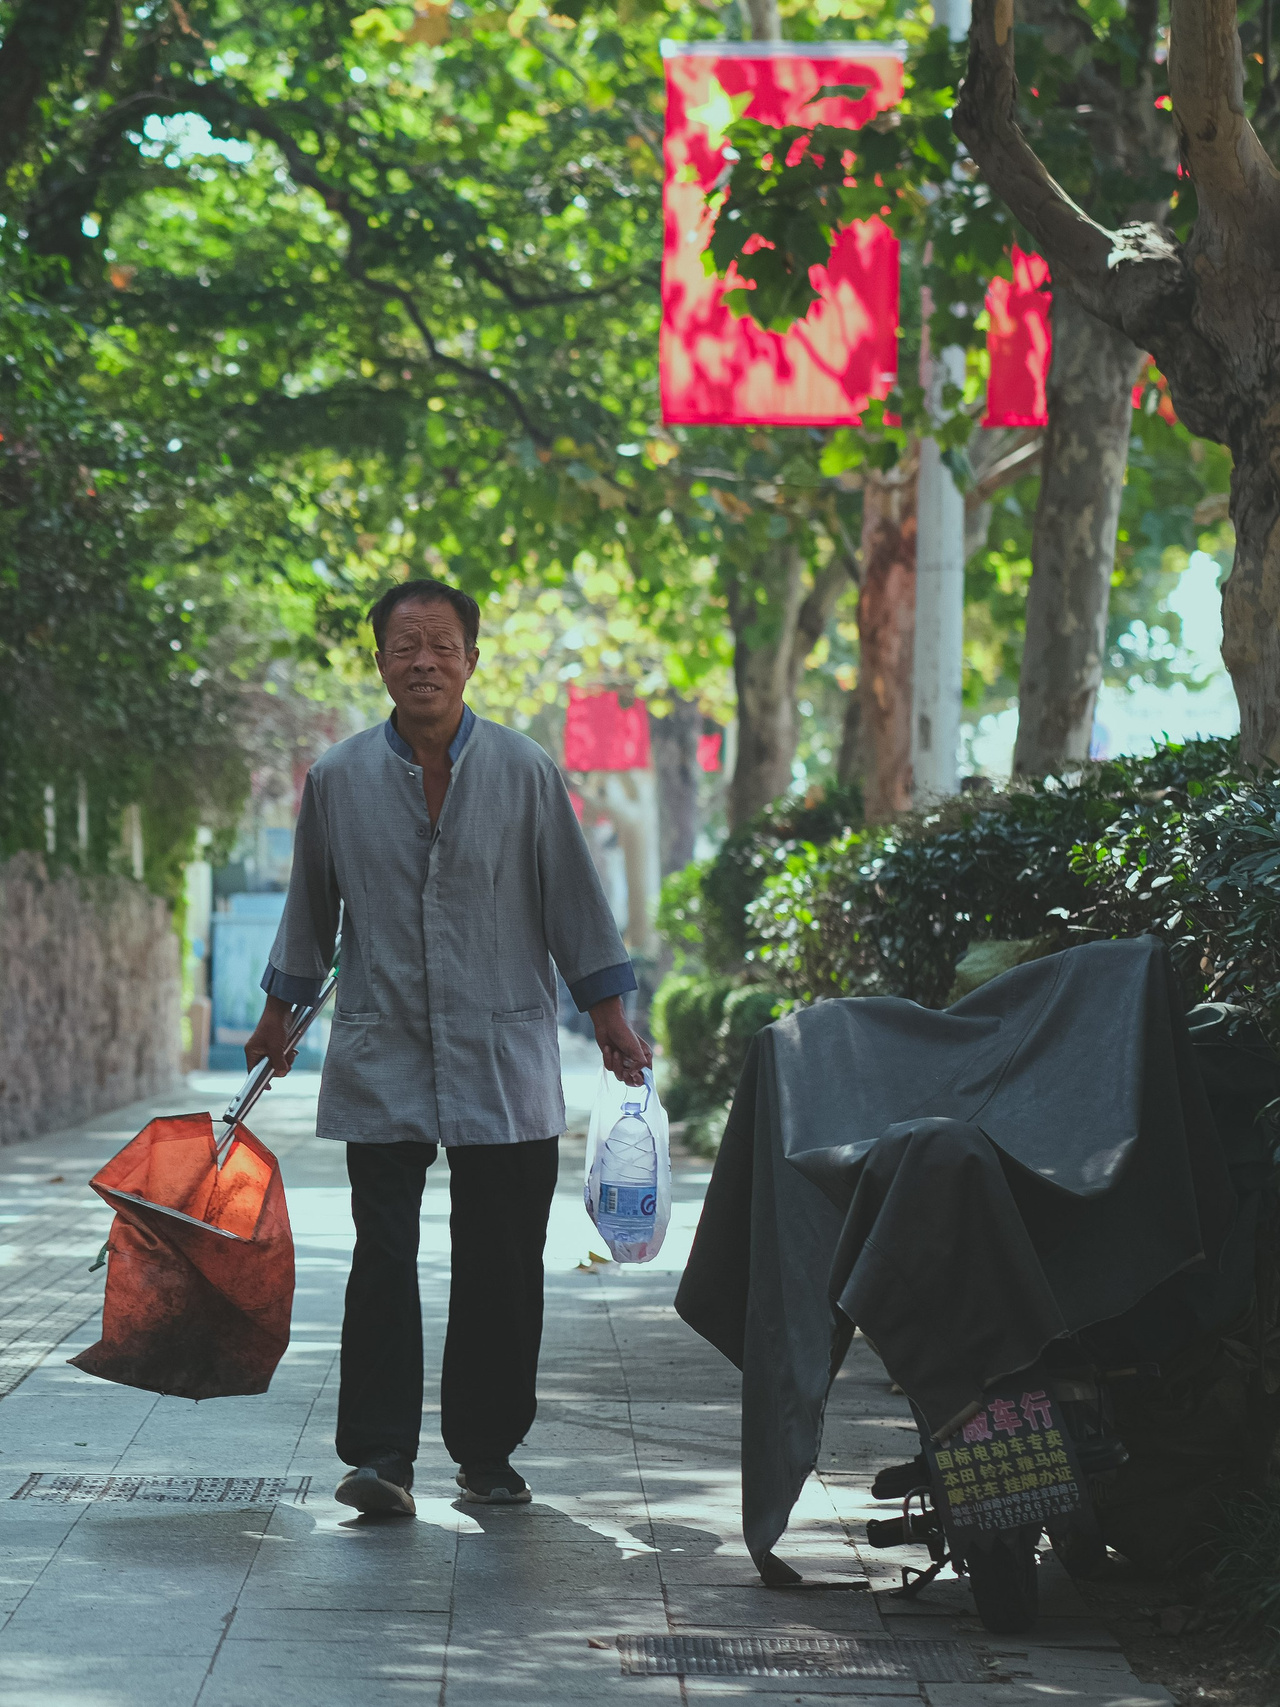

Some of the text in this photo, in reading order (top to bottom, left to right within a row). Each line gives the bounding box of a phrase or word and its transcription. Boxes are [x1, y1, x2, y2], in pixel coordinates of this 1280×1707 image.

[935, 1429, 1063, 1470] 国标电动车专卖
[943, 1451, 1068, 1486] 本田 铃木 雅马哈
[948, 1466, 1074, 1505] 摩托车 挂牌办证
